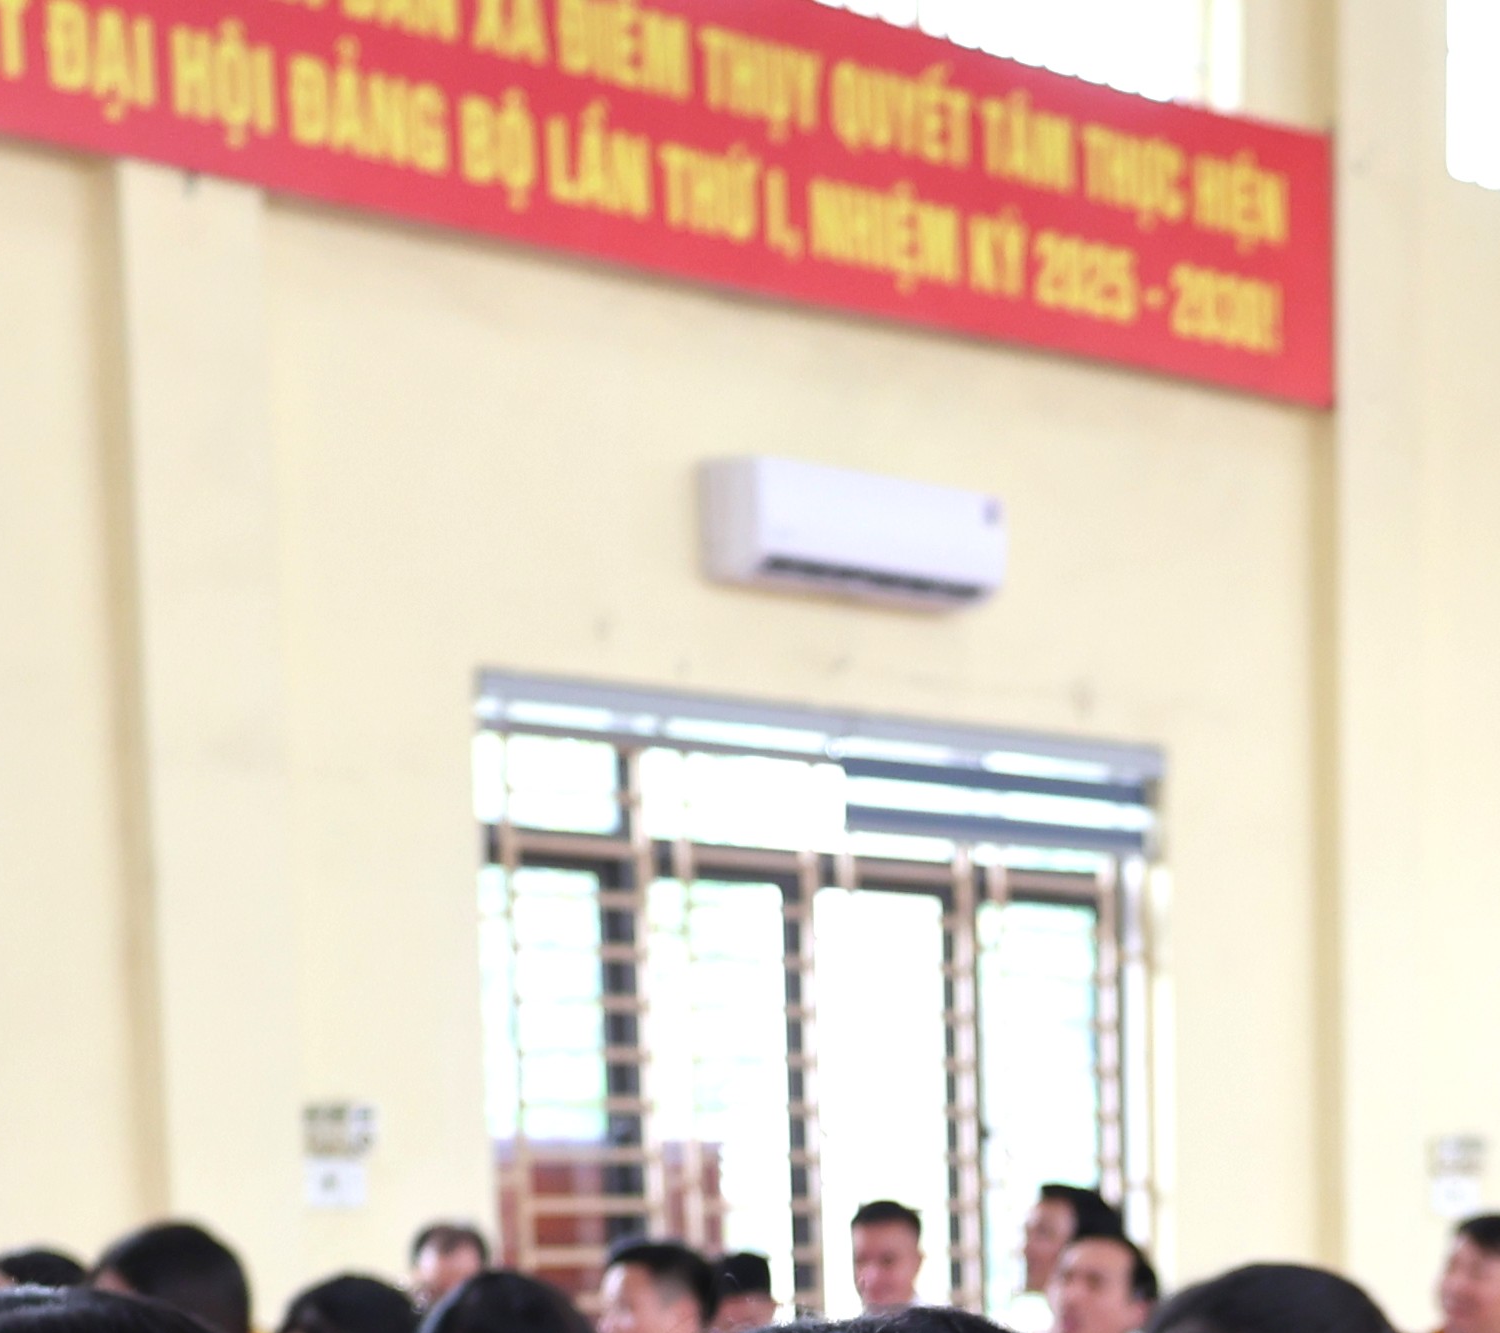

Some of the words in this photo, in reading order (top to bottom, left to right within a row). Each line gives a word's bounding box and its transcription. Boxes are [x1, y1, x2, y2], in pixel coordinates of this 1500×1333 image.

[47, 0, 156, 124] ĐẠI
[169, 16, 277, 149] HỘI
[288, 34, 449, 178] ĐẢNG
[459, 86, 538, 213] BỘ
[659, 140, 765, 244] THỨ
[808, 178, 961, 296] NHIỆM
[967, 204, 1029, 299] KỲ
[1033, 229, 1140, 325] 2025
[829, 62, 972, 170] QUYẾT
[981, 86, 1076, 195] TÂM
[1192, 149, 1288, 254] HIỆN
